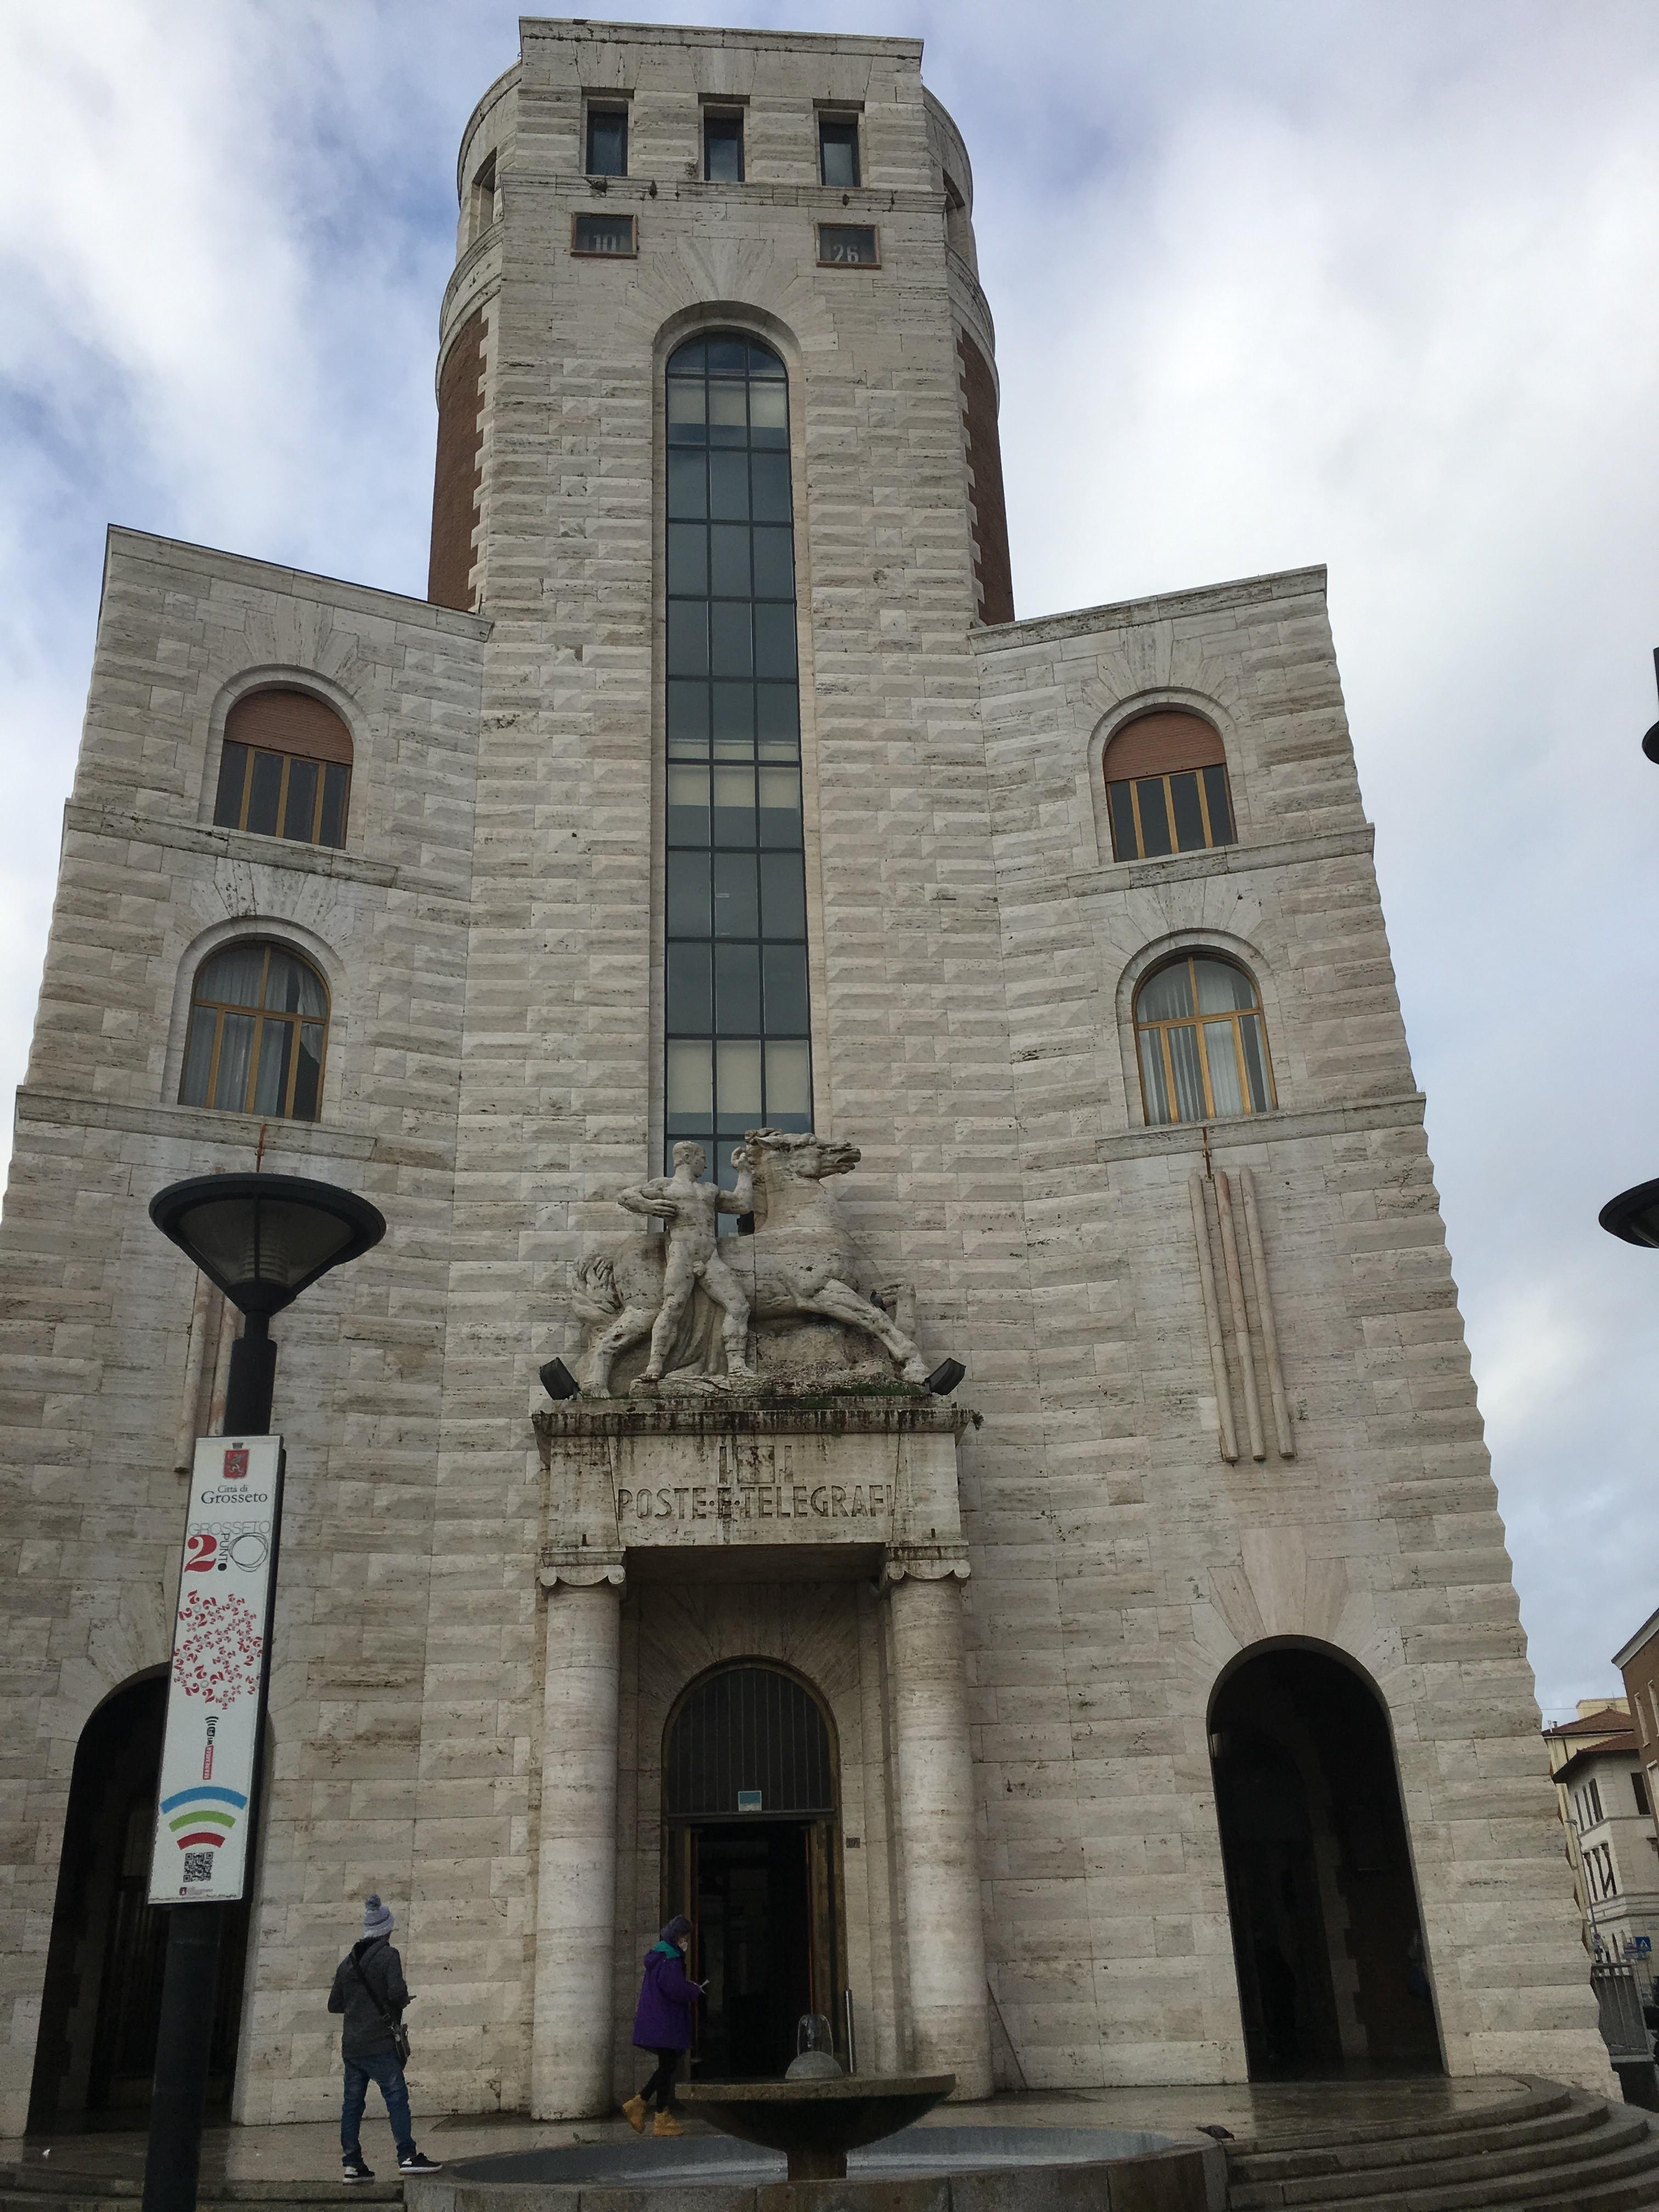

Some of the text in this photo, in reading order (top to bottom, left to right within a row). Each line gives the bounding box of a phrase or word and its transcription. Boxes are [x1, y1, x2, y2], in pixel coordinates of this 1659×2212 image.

[833, 245, 859, 262] 26
[201, 1491, 268, 1504] Grosseto
[618, 1485, 894, 1521] POSTE E TELEGRAFI
[188, 1520, 271, 1536] GROSSETO
